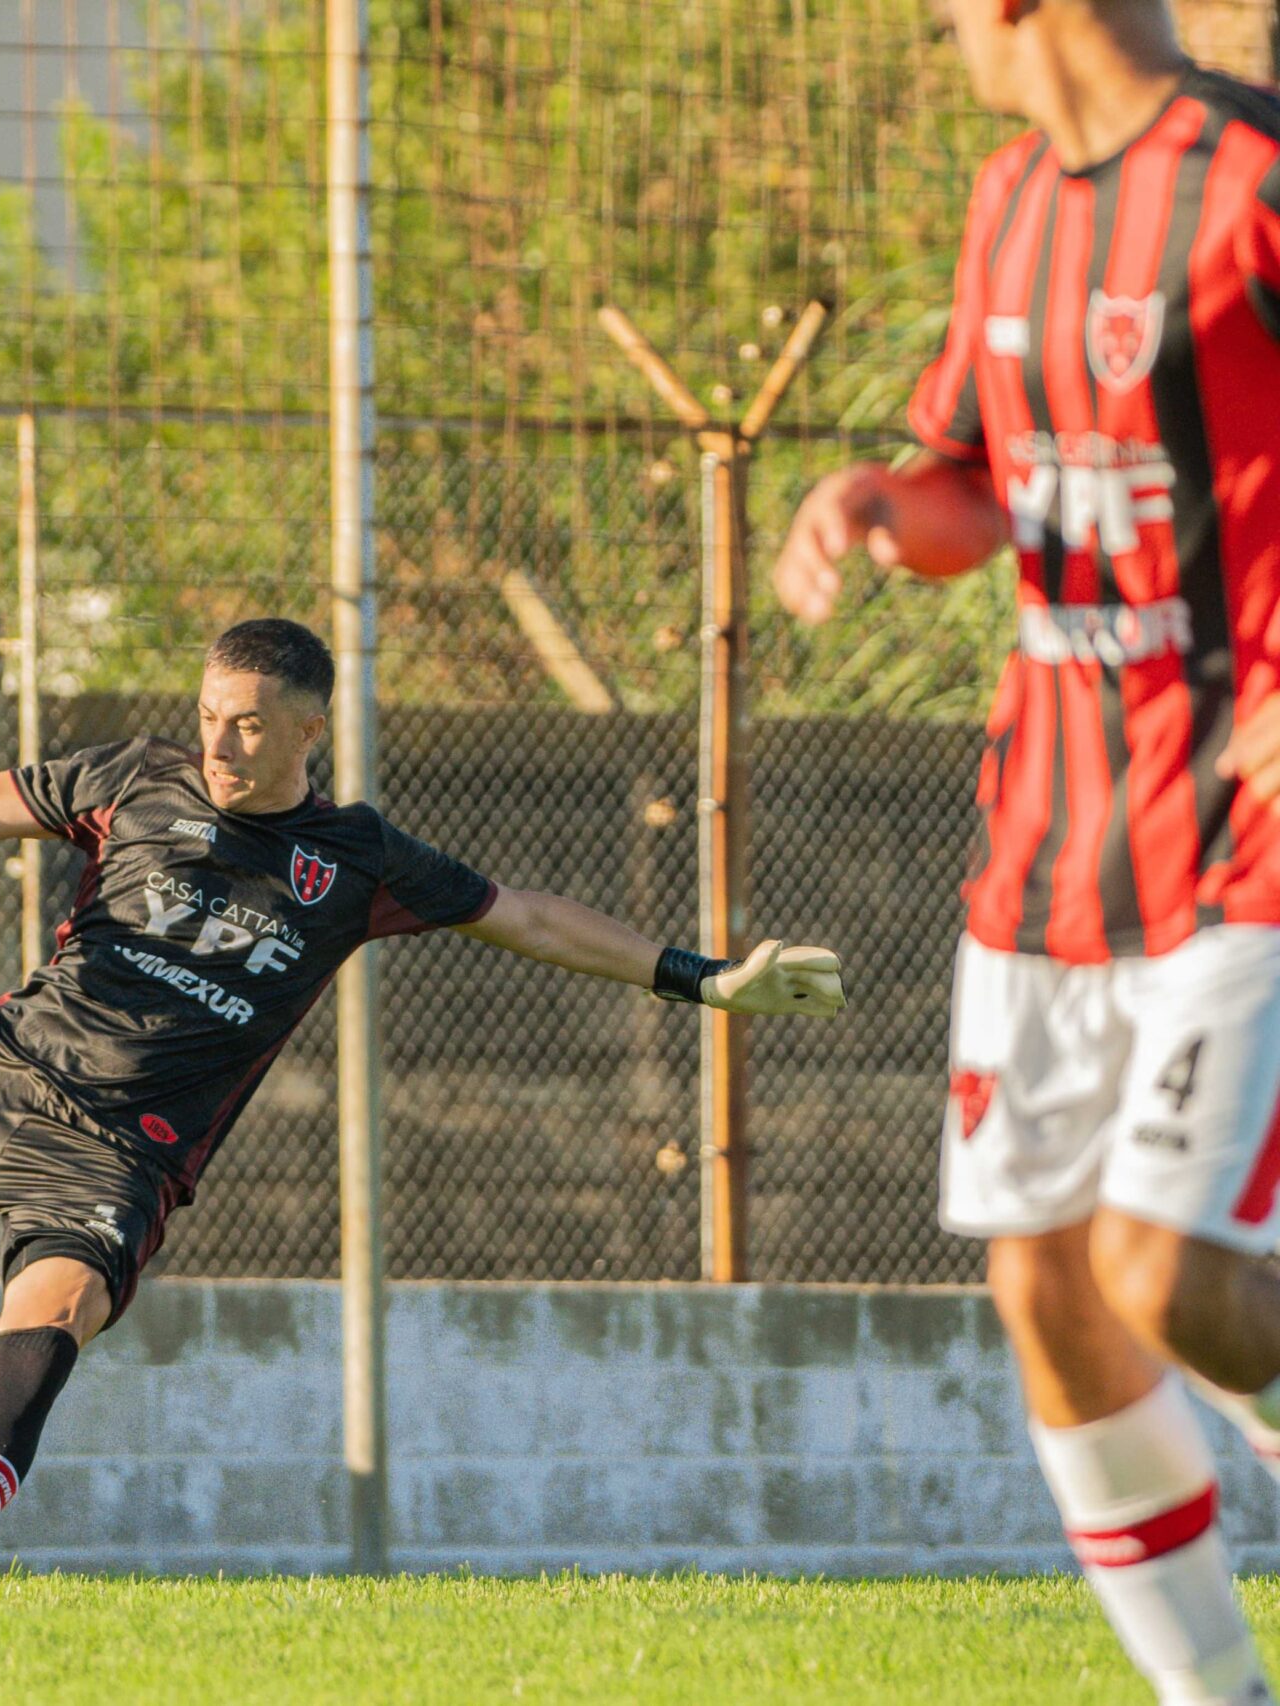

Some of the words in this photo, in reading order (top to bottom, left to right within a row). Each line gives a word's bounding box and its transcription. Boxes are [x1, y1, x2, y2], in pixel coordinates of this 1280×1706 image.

[147, 871, 204, 906] CASA
[144, 888, 301, 975] YPF
[1158, 1037, 1204, 1112] 4
